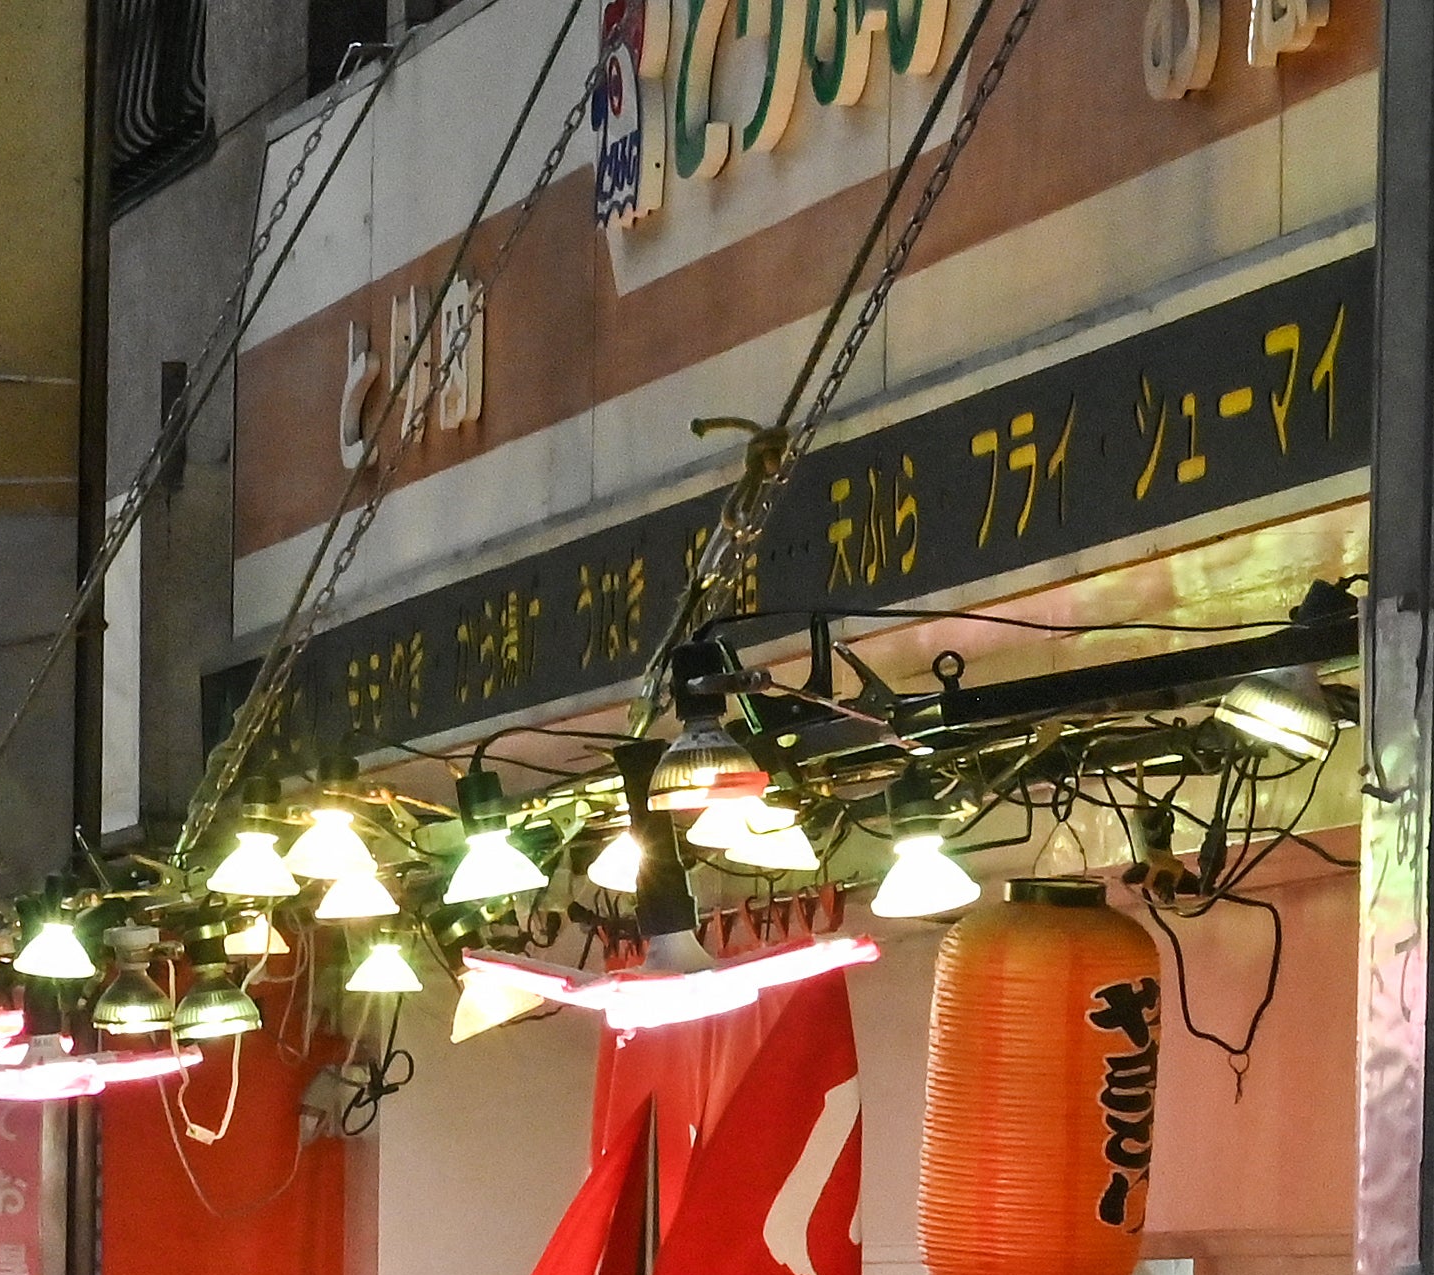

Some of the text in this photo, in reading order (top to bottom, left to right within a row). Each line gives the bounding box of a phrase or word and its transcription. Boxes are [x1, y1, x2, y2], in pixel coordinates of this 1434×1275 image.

[825, 453, 919, 597] 天ぷら
[970, 396, 1076, 552] フライ
[1135, 302, 1346, 503] シューマイ
